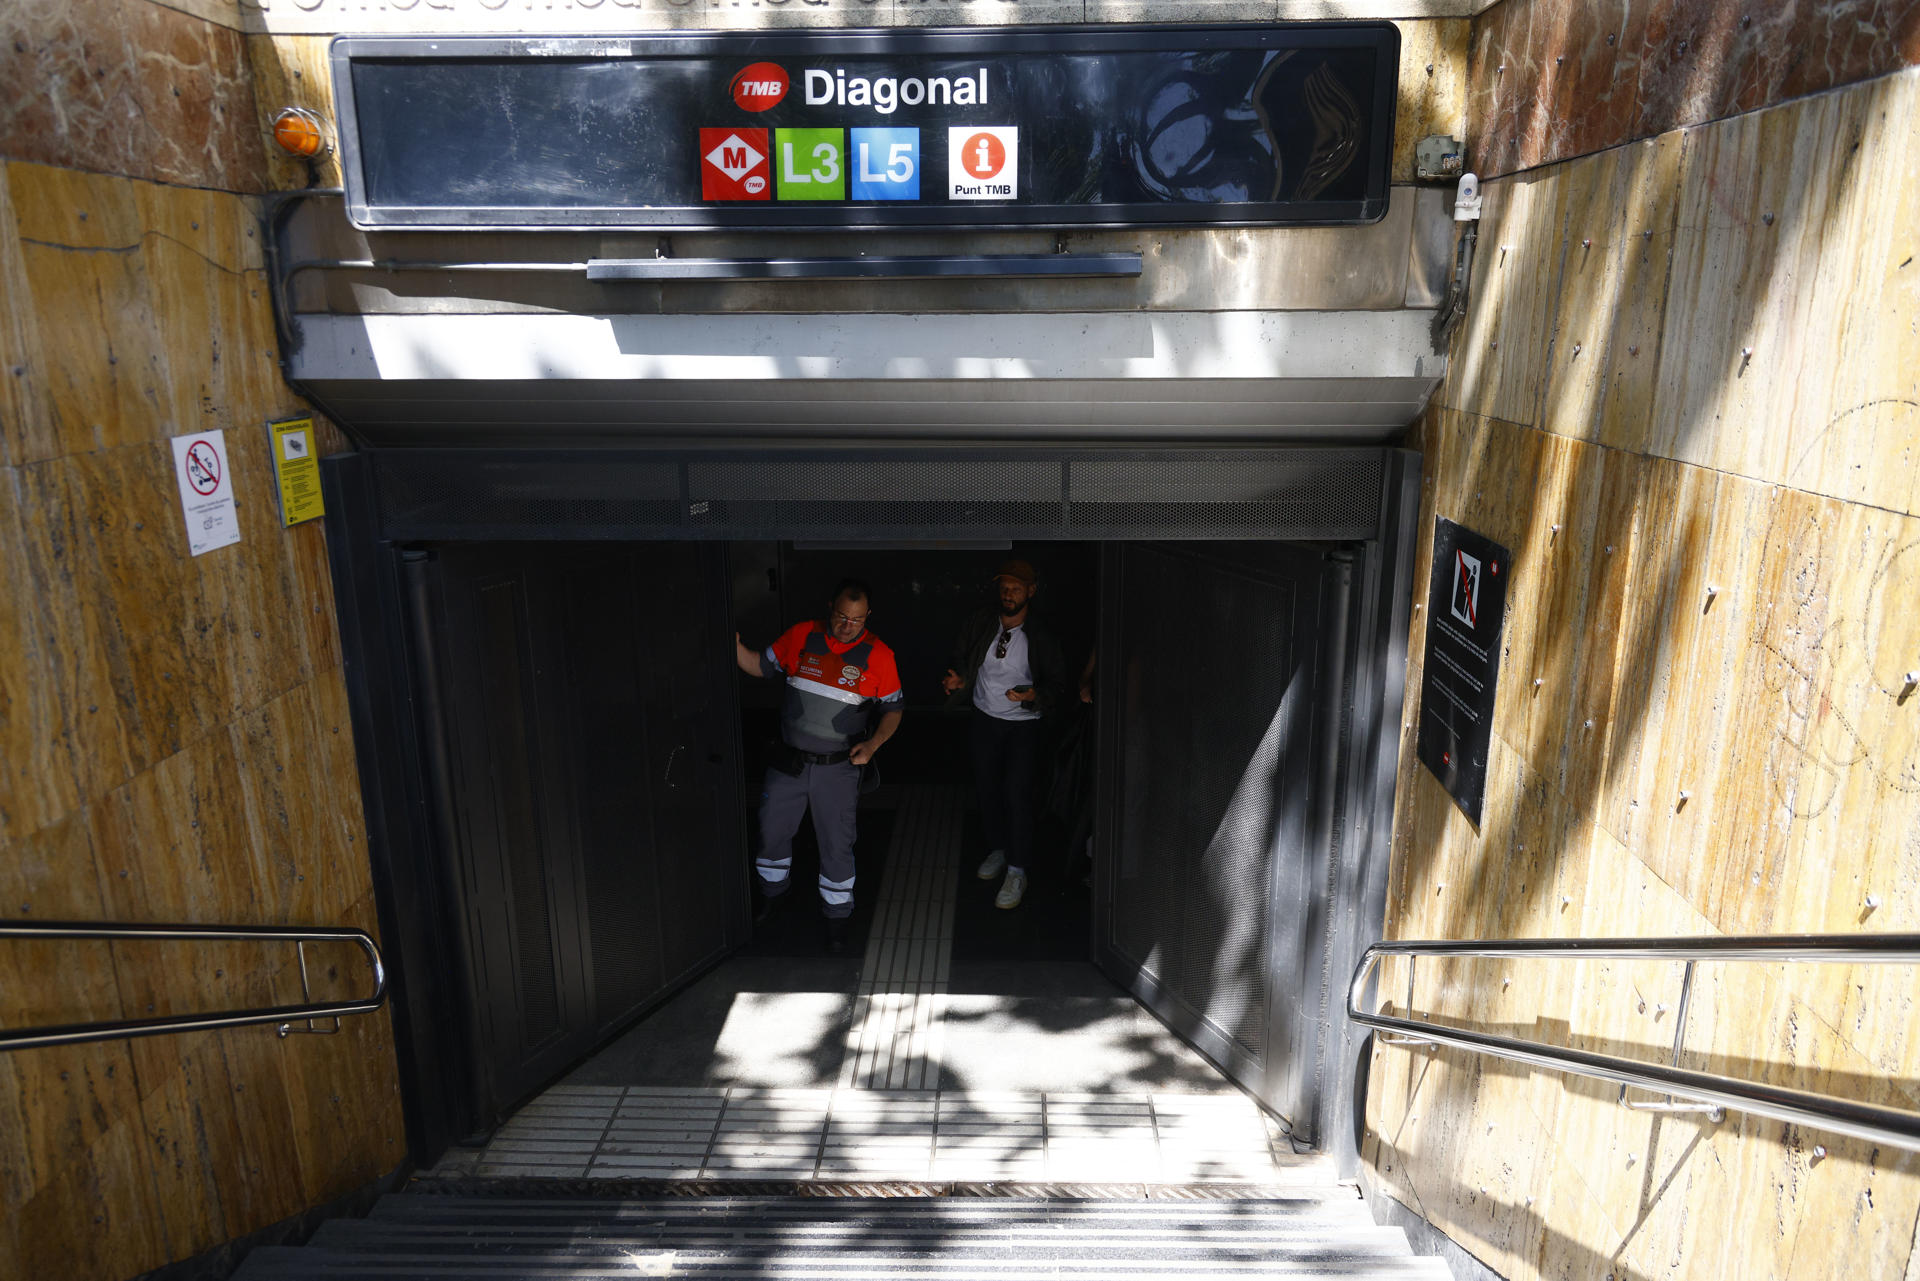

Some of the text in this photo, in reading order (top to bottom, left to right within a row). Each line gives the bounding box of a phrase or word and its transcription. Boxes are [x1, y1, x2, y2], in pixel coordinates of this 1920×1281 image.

[742, 81, 782, 96] TMB
[804, 68, 988, 114] Diagonal
[723, 147, 747, 169] M
[783, 142, 840, 184] L3
[859, 142, 914, 183] L5
[748, 181, 763, 189] TMB
[955, 184, 1012, 195] Punt TMB
